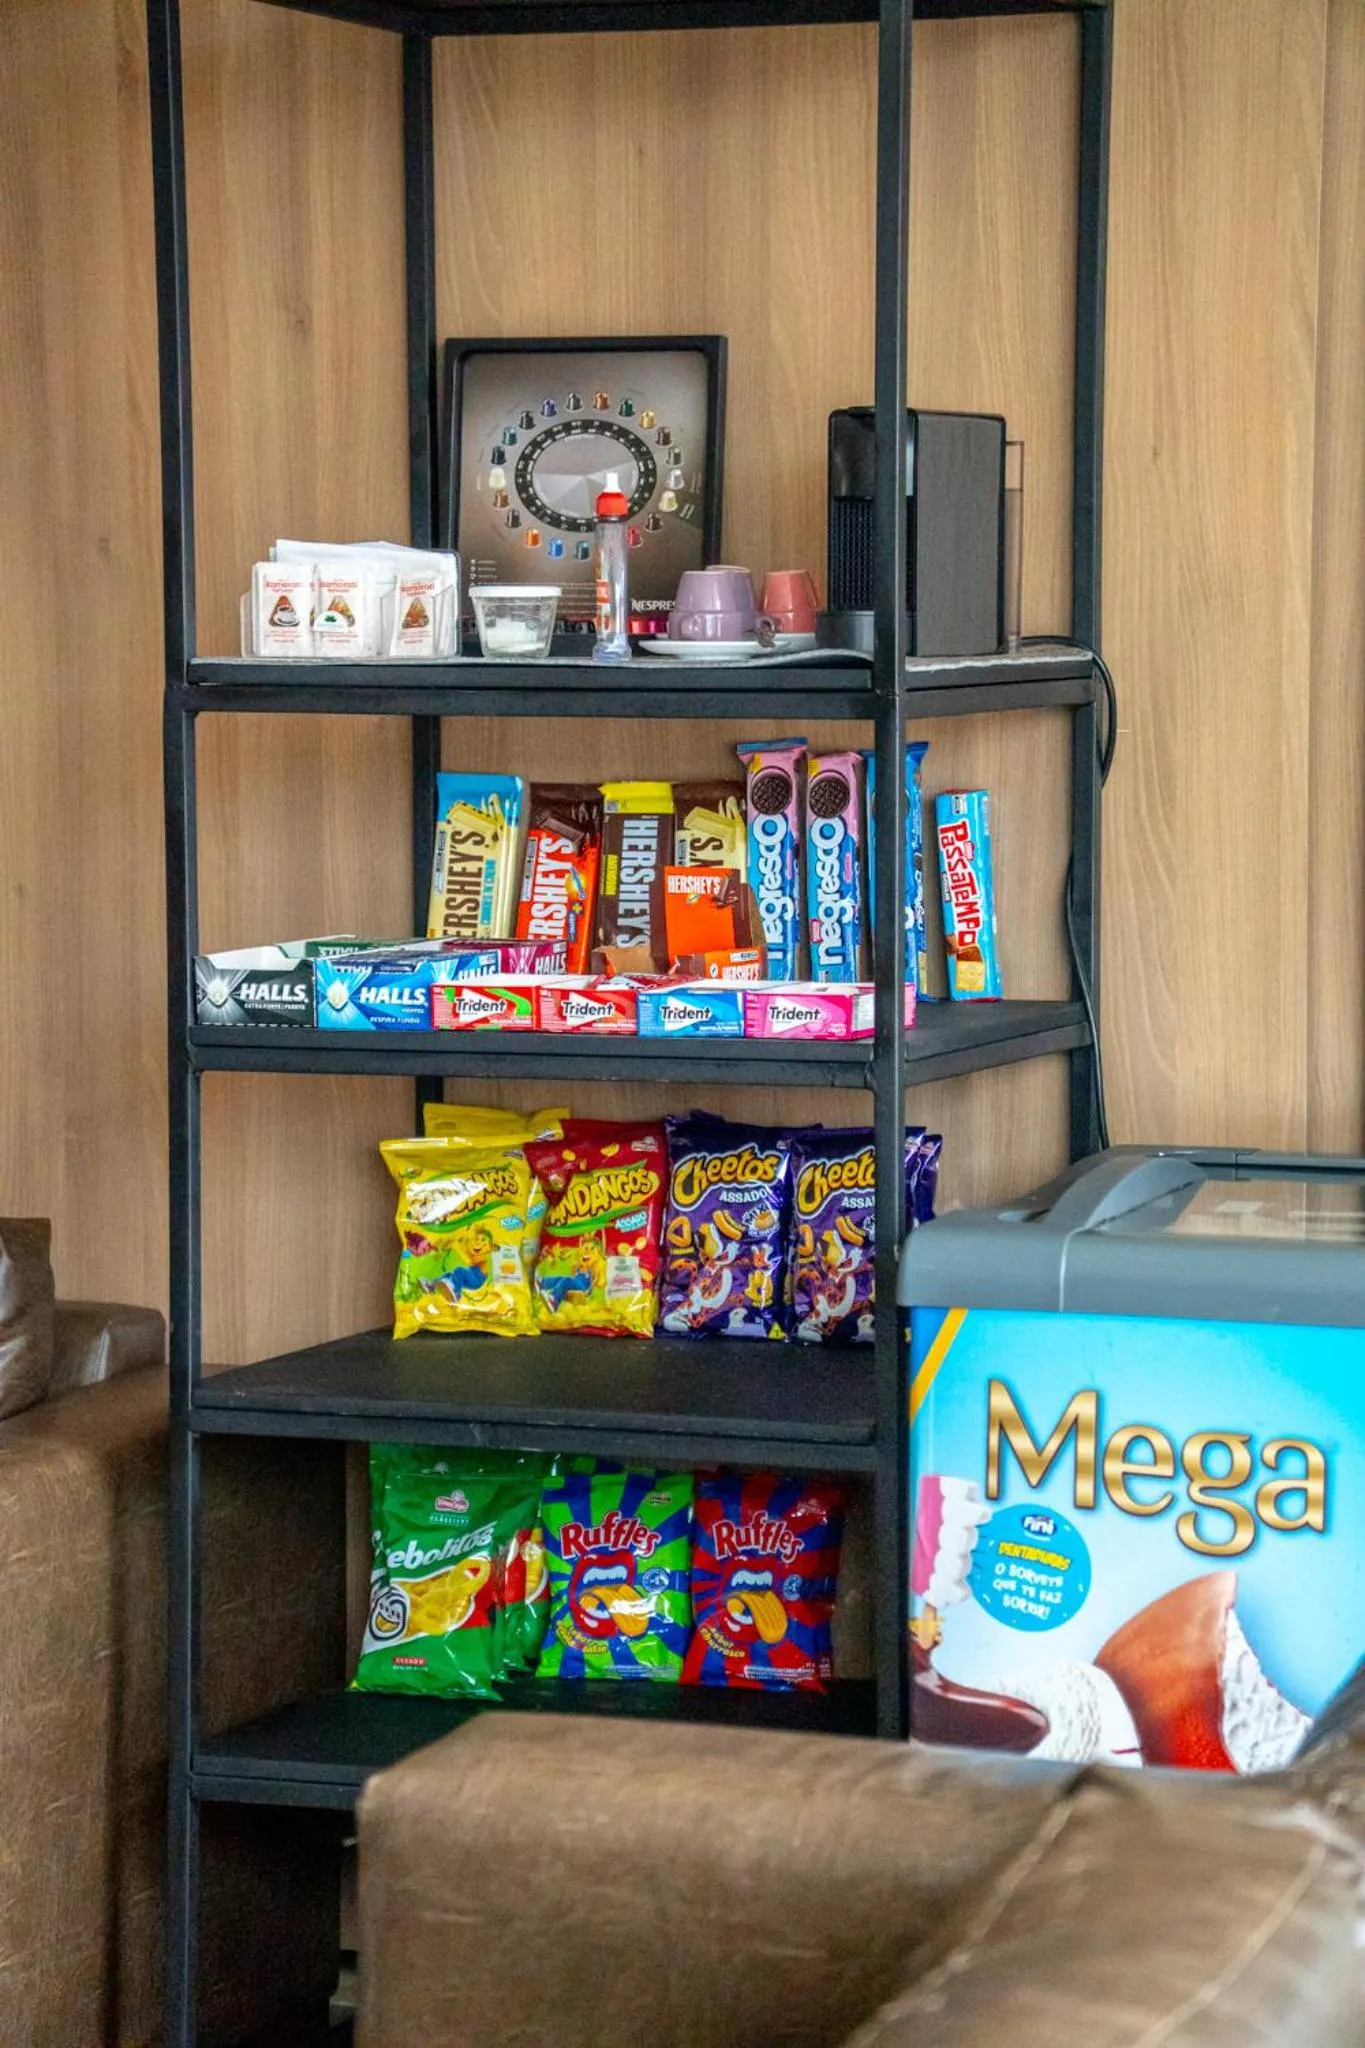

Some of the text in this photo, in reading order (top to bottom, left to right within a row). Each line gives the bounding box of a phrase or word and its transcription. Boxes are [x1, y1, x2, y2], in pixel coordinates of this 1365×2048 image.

[631, 598, 677, 613] NESPRE
[443, 830, 486, 938] ERSHEY'S
[528, 837, 573, 940] RSHEY'S
[616, 819, 658, 948] HERSHEY'S
[667, 874, 721, 895] HERSHEY'S
[536, 953, 567, 975] HALLS
[240, 983, 307, 1002] HALLS
[360, 986, 426, 1006] HALLS
[456, 998, 506, 1012] Trident
[563, 1001, 614, 1015] Trident
[661, 1005, 711, 1020] Trident
[769, 1006, 821, 1020] Trident
[673, 1147, 781, 1207] Cheetos
[797, 1152, 875, 1214] Cheet
[548, 1168, 653, 1226] NDANGOS
[719, 1190, 769, 1203] ASSADO
[841, 1196, 875, 1208] ASSA
[985, 1378, 1328, 1557] Mega
[559, 1510, 661, 1558] Ruffles
[712, 1510, 805, 1564] Ruffles
[994, 1562, 1064, 1588] O SORVETE
[992, 1578, 1063, 1605] QUE TE FAZ
